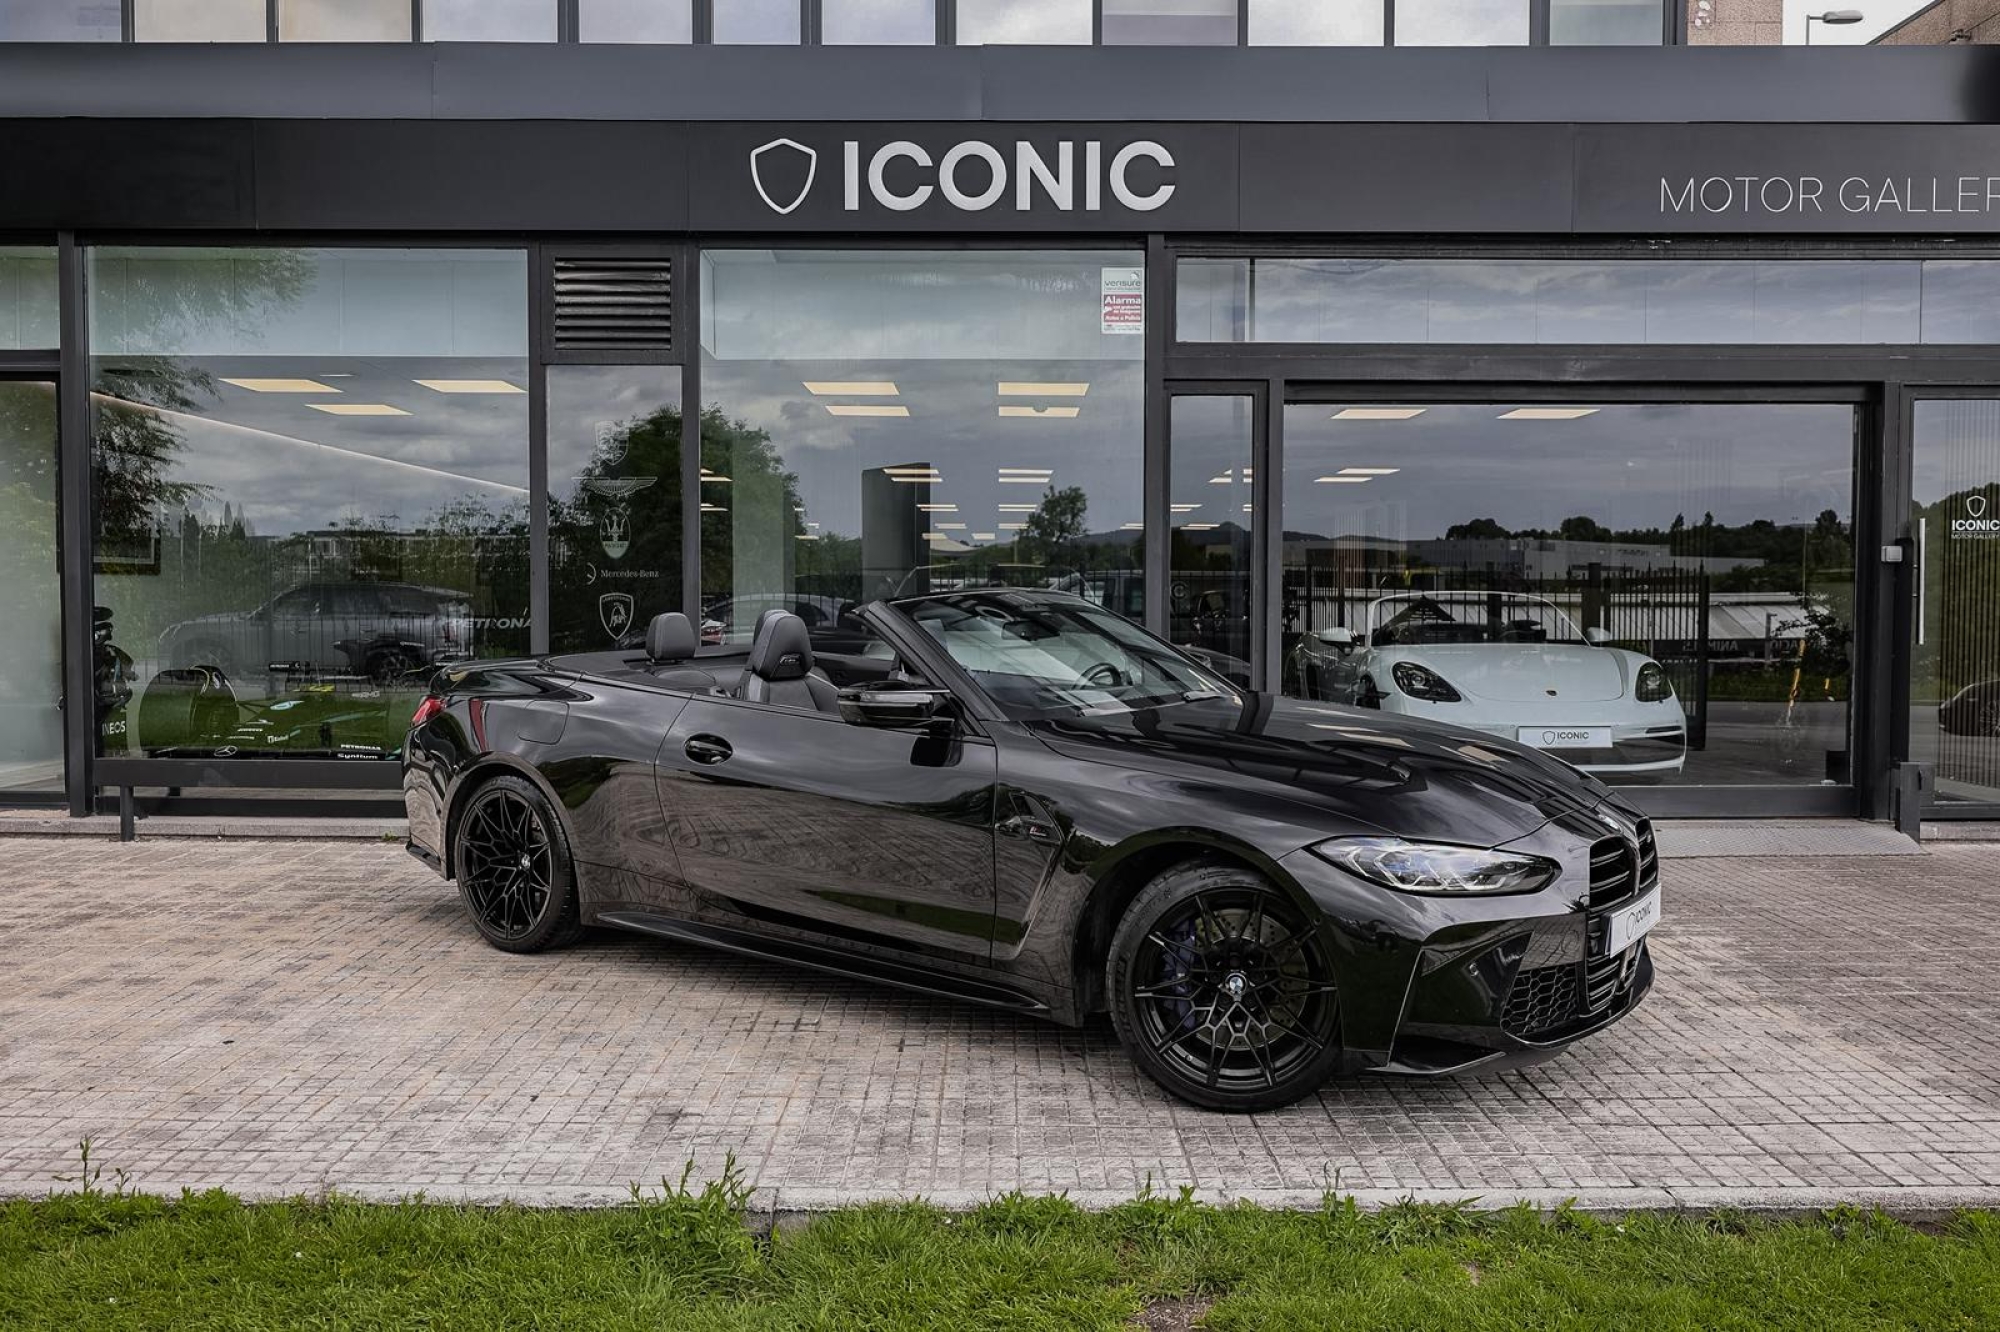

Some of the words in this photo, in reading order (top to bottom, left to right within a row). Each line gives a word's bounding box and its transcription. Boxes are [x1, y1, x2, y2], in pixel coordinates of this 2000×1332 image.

[844, 140, 1176, 211] ICONIC
[1660, 176, 1823, 212] MOTOR
[1105, 296, 1141, 304] Alarma
[1951, 519, 2000, 531] ICONIC
[600, 569, 659, 578] Mercedes-Benz
[102, 720, 126, 736] INEOS
[1557, 731, 1589, 740] ICONIC
